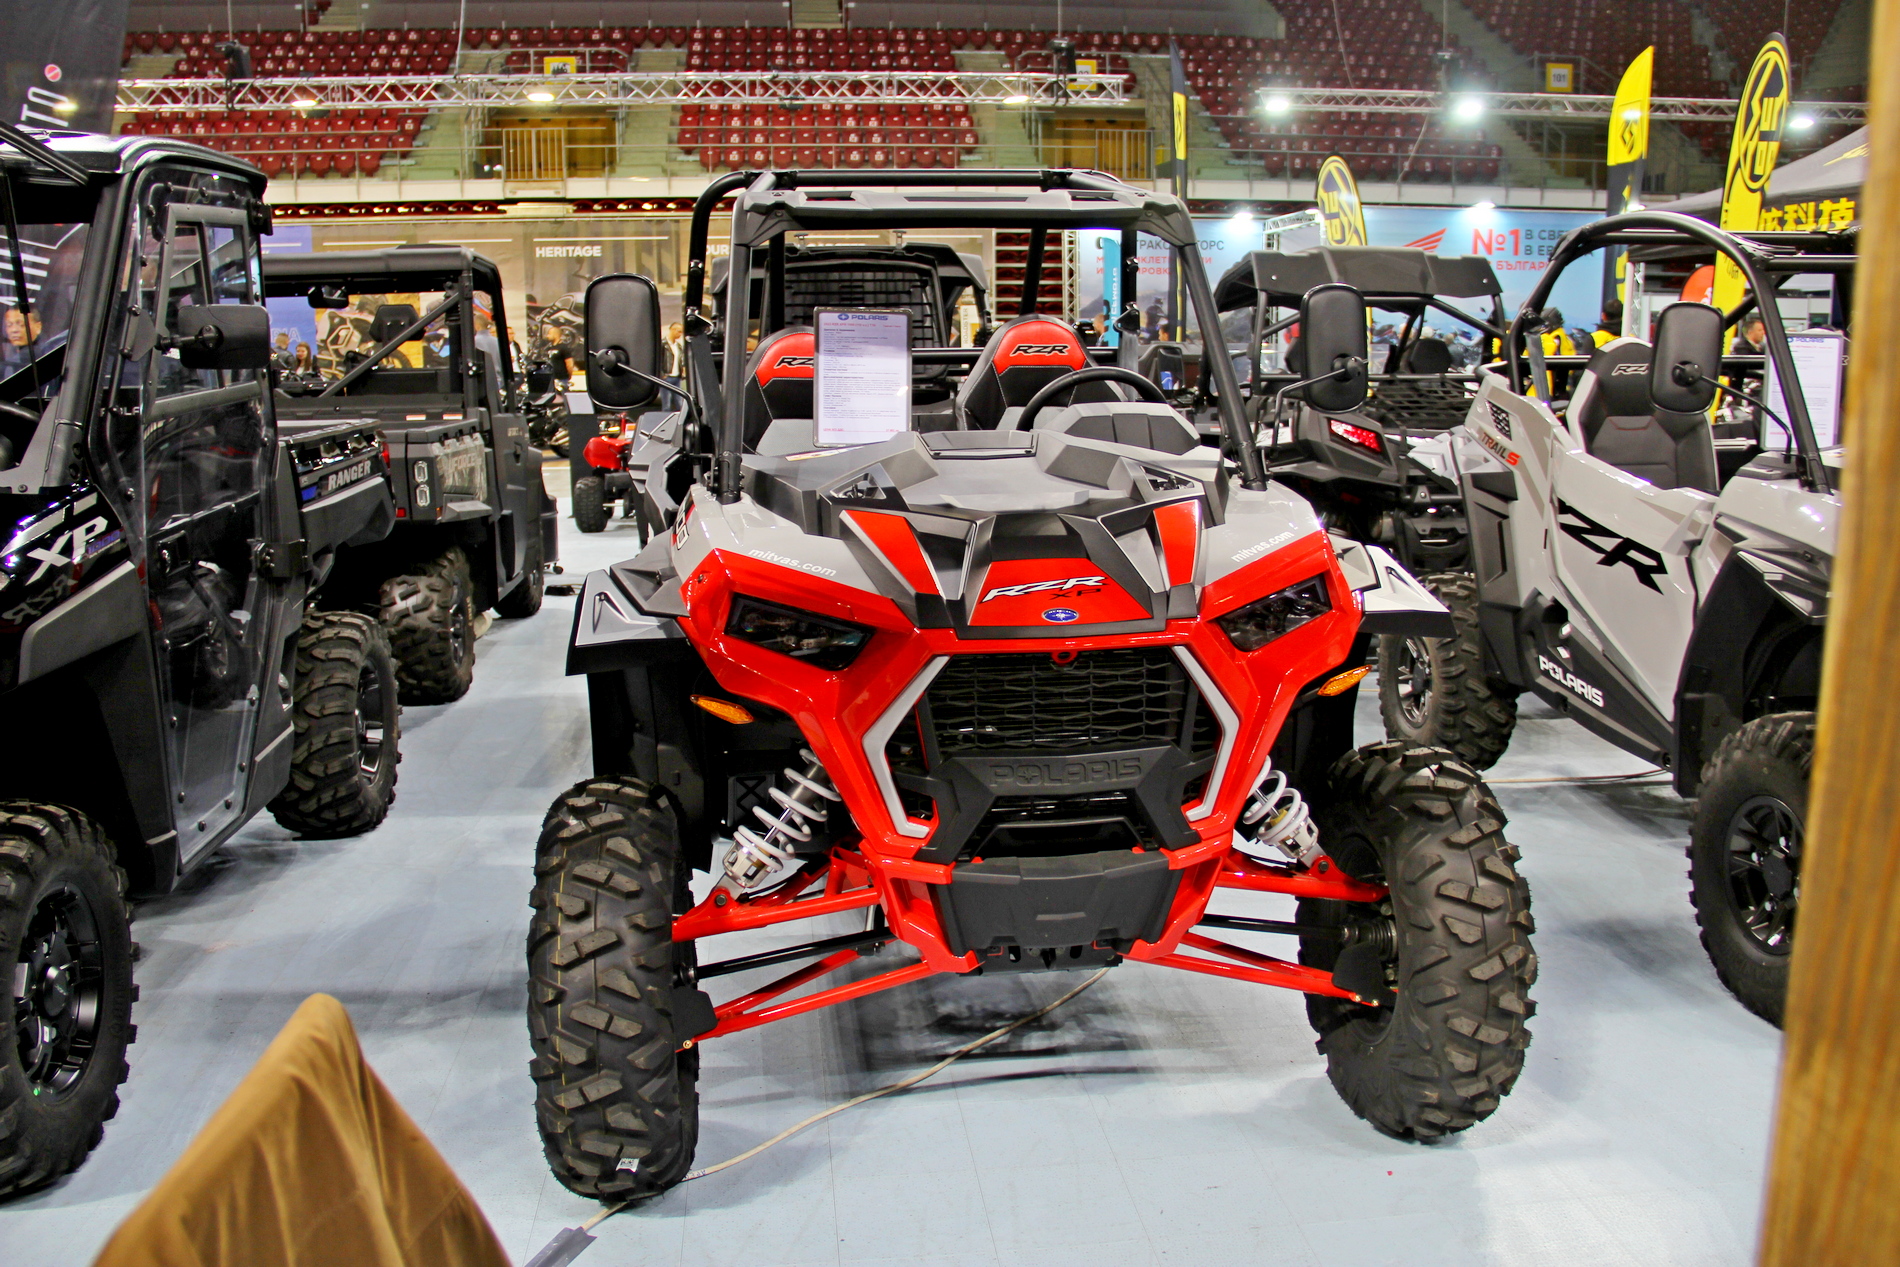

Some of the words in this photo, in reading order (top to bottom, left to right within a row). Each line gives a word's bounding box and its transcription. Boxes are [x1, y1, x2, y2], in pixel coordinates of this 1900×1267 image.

[1525, 229, 1533, 240] В
[535, 245, 602, 258] HERITAGE
[773, 355, 815, 369] RZ
[1009, 343, 1071, 357] RZR
[1611, 363, 1650, 376] RZ
[328, 459, 371, 491] RANGER
[25, 516, 108, 586] XP
[1230, 531, 1295, 563] mitvas.com
[1558, 497, 1668, 595] ZR
[748, 549, 837, 577] mitvas.com
[978, 575, 1108, 604] RZR
[1049, 588, 1102, 600] XP
[1538, 654, 1605, 708] POLARIS
[989, 756, 1144, 787] POLARIS
